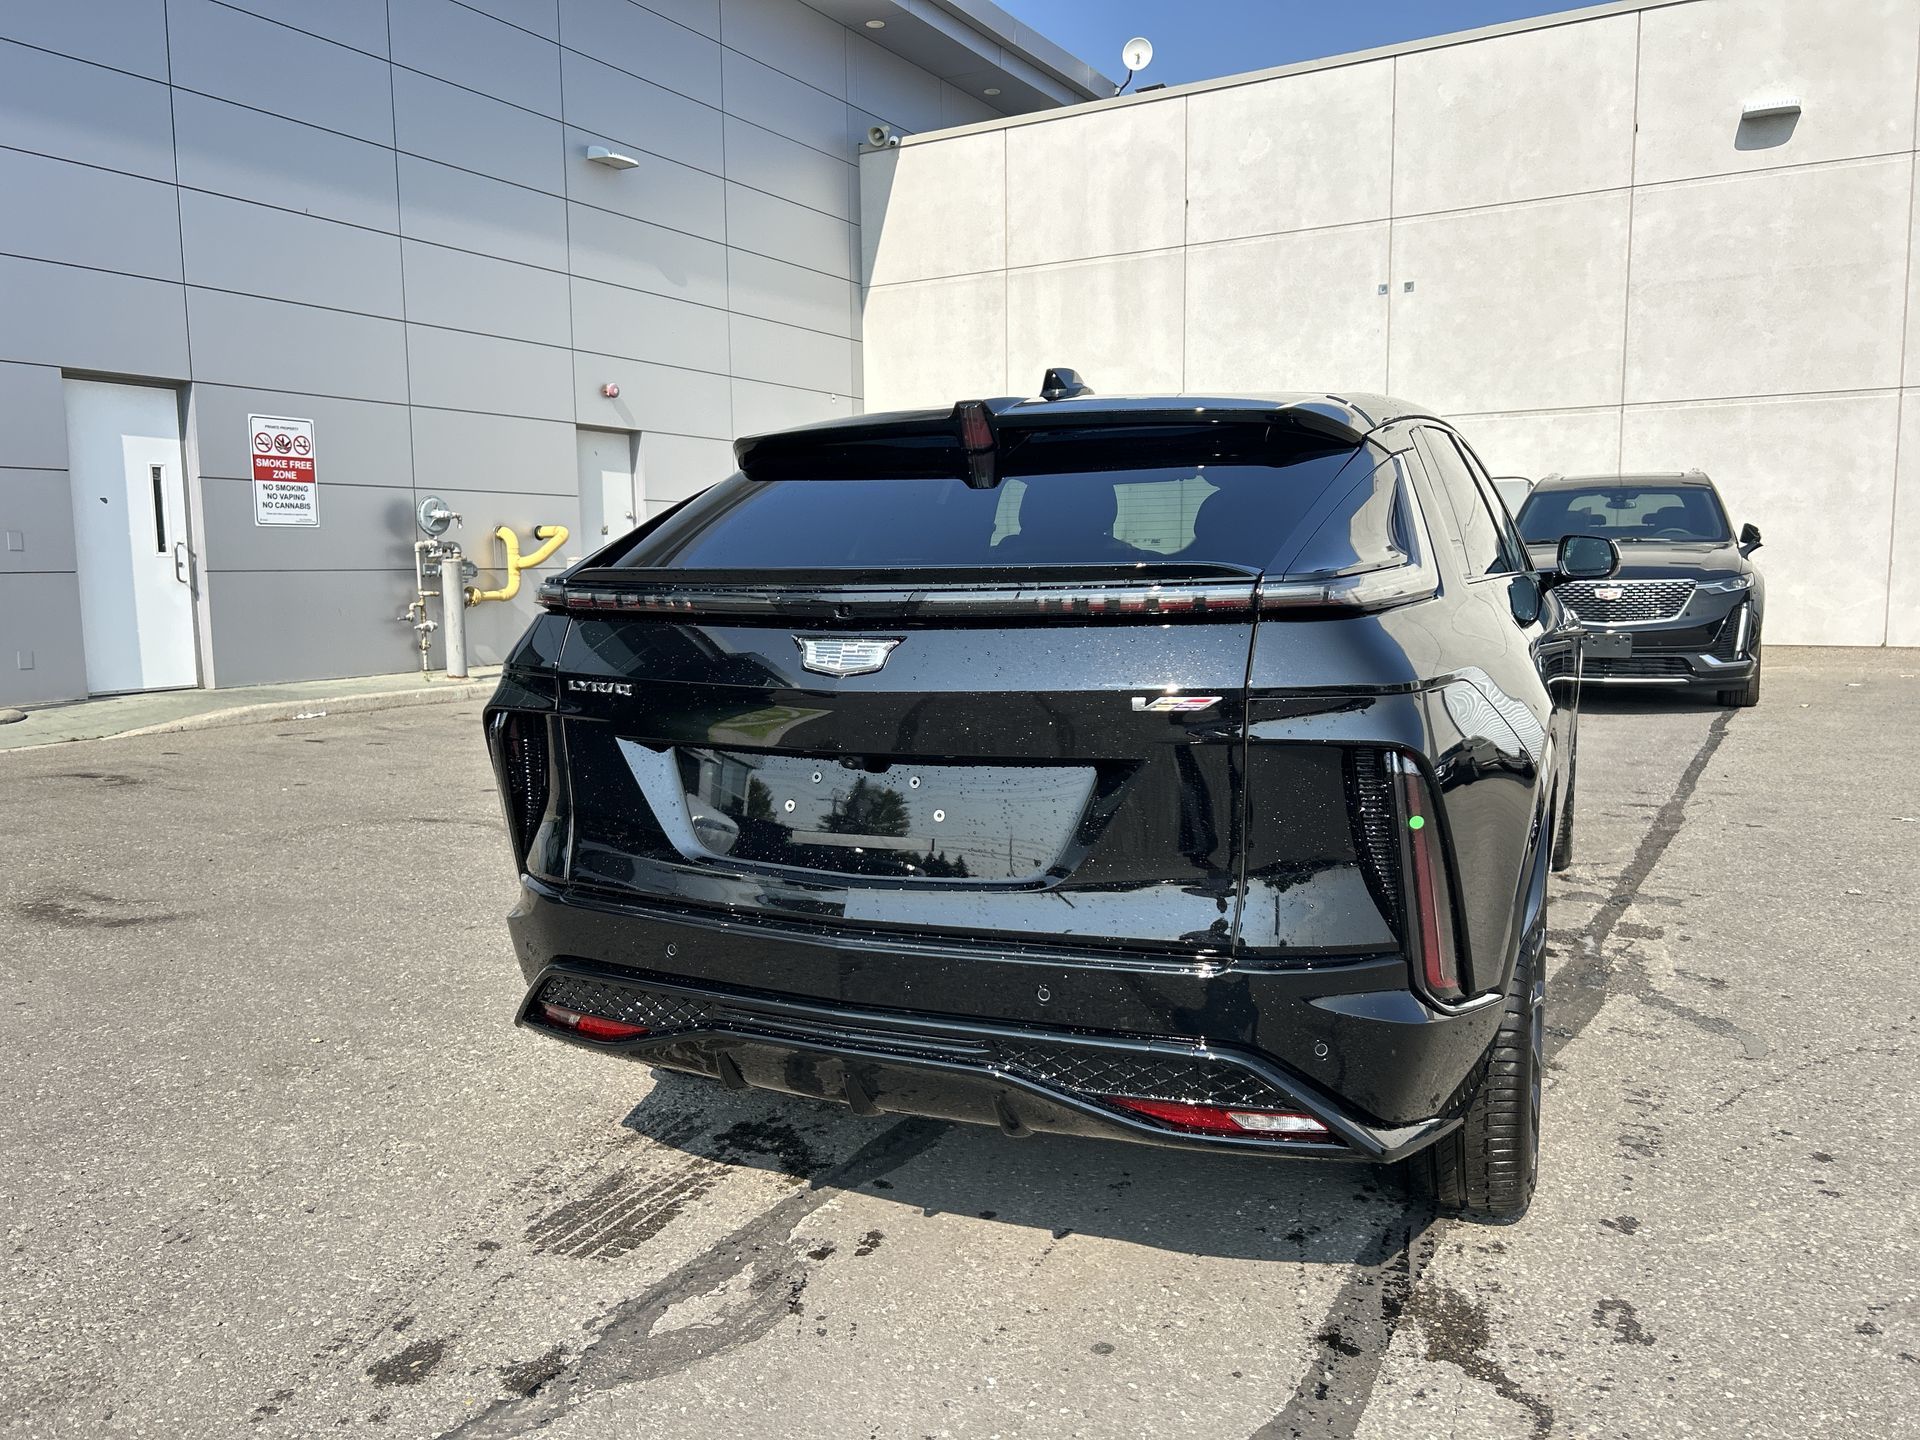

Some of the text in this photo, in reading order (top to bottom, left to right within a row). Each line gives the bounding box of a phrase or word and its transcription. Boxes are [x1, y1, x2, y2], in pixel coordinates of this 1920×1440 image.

[256, 458, 313, 470] SMOKE FREE
[273, 470, 297, 480] ZONE
[275, 484, 309, 492] SMOKING
[267, 492, 306, 501] NO VAPING
[274, 502, 311, 510] CANNABIS
